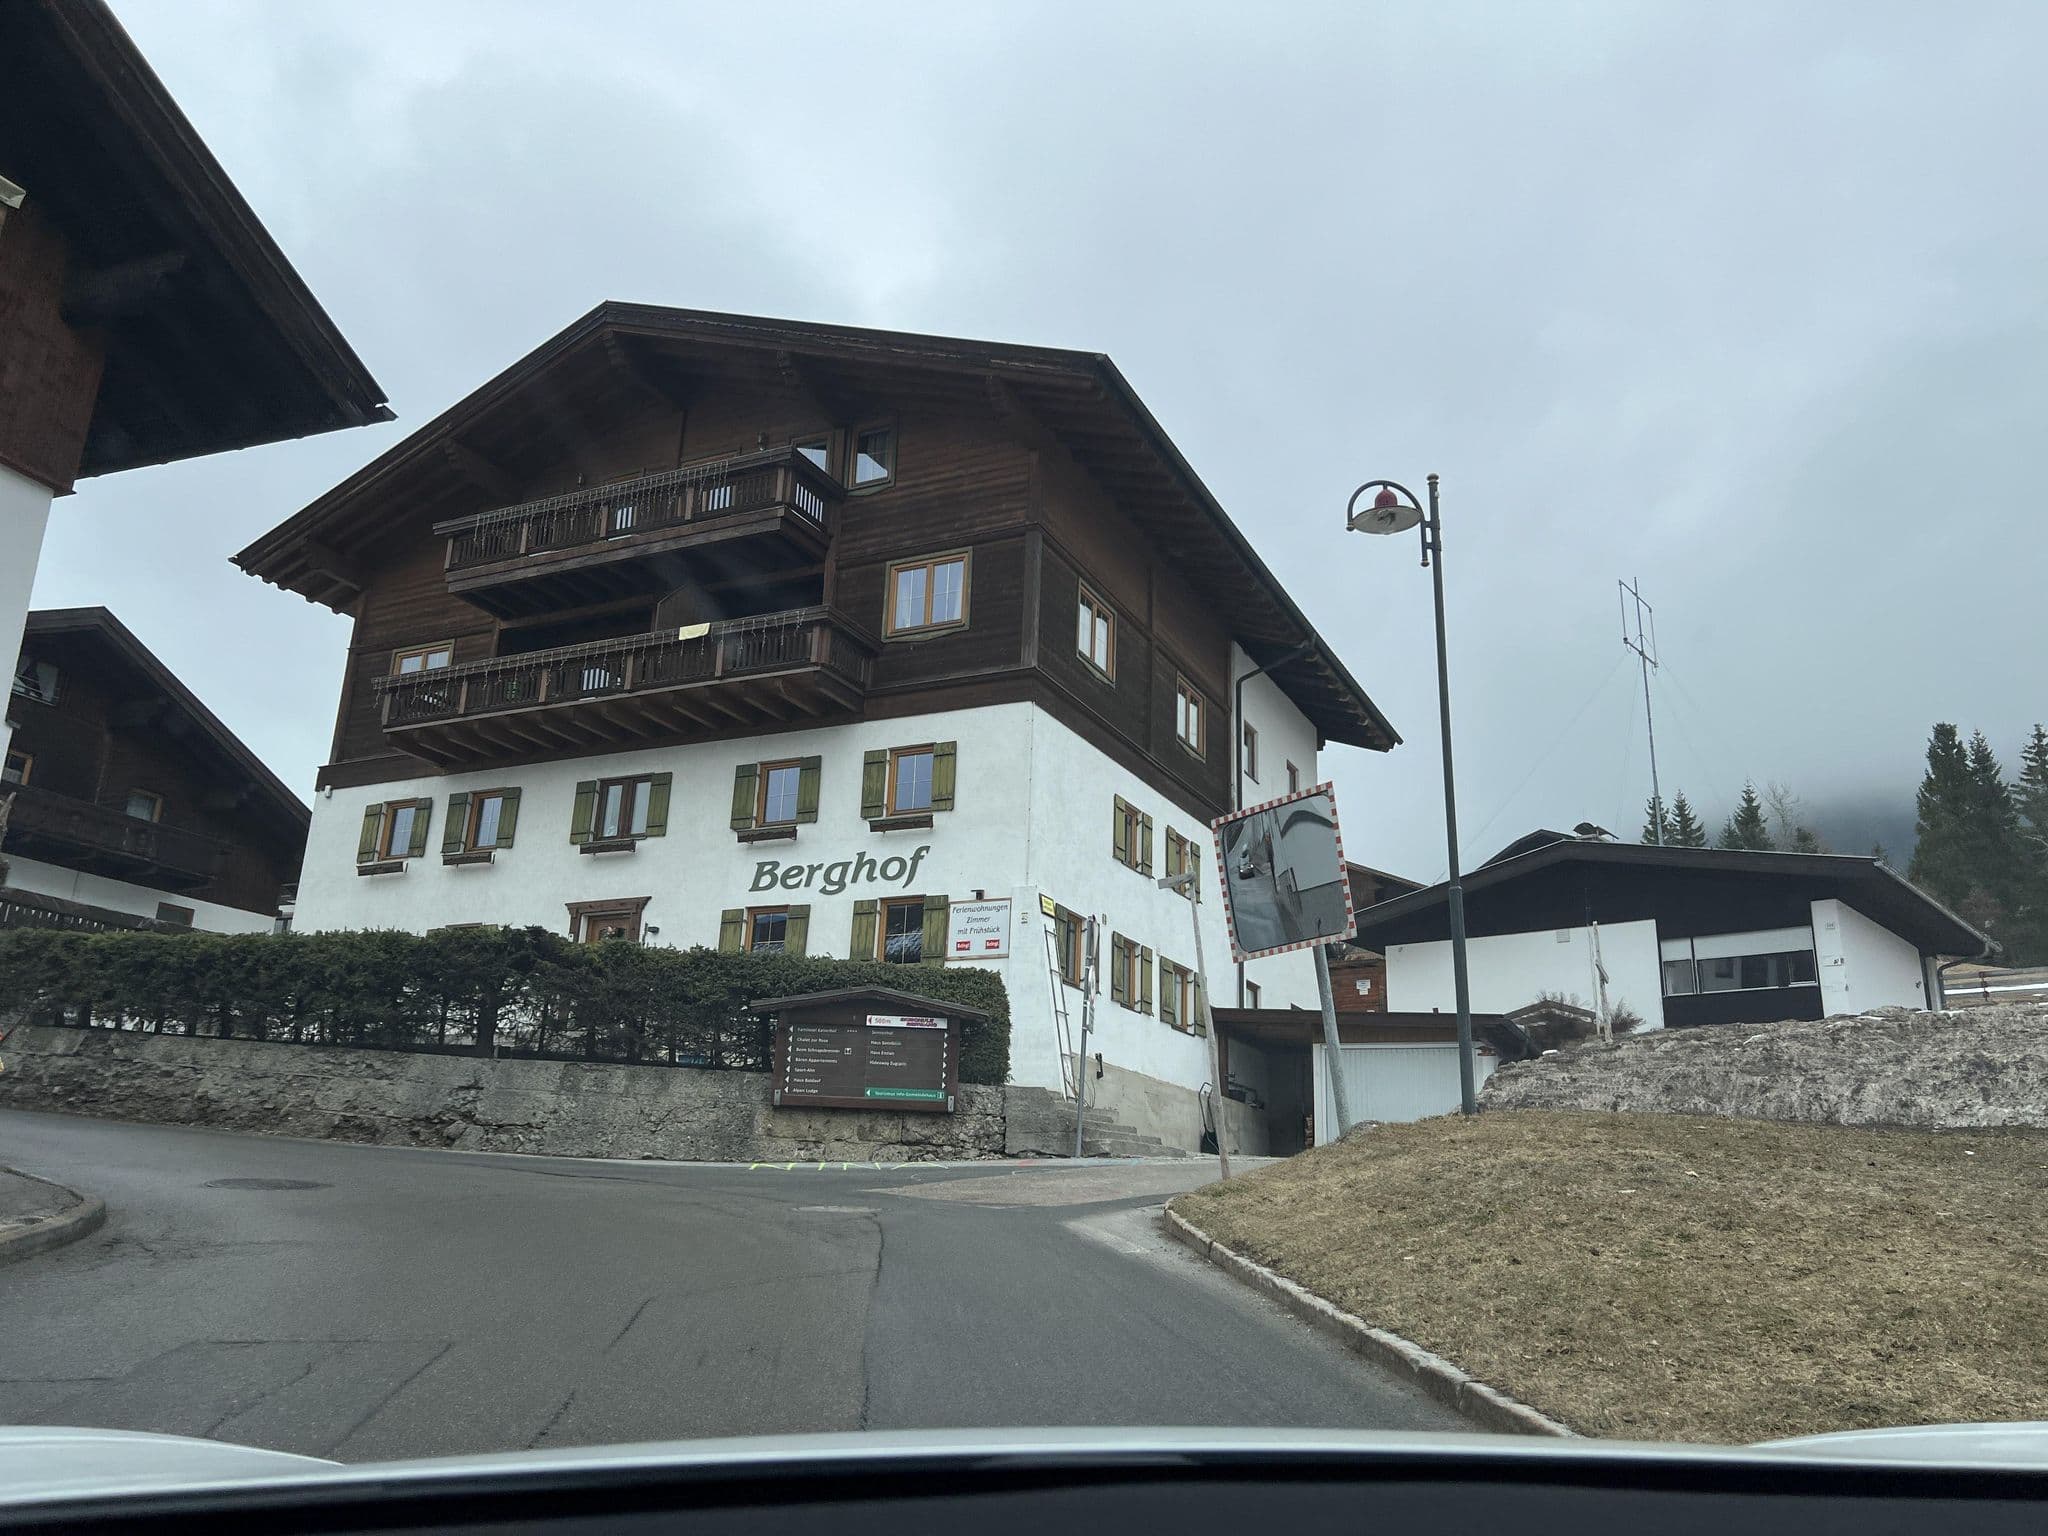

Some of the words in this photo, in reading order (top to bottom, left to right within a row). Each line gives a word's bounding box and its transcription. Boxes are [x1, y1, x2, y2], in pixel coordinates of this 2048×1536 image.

[749, 845, 931, 896] Berghof
[952, 904, 1008, 914] Ferienwohnungen
[966, 916, 992, 924] Zimmer
[969, 925, 1001, 935] Frühstück
